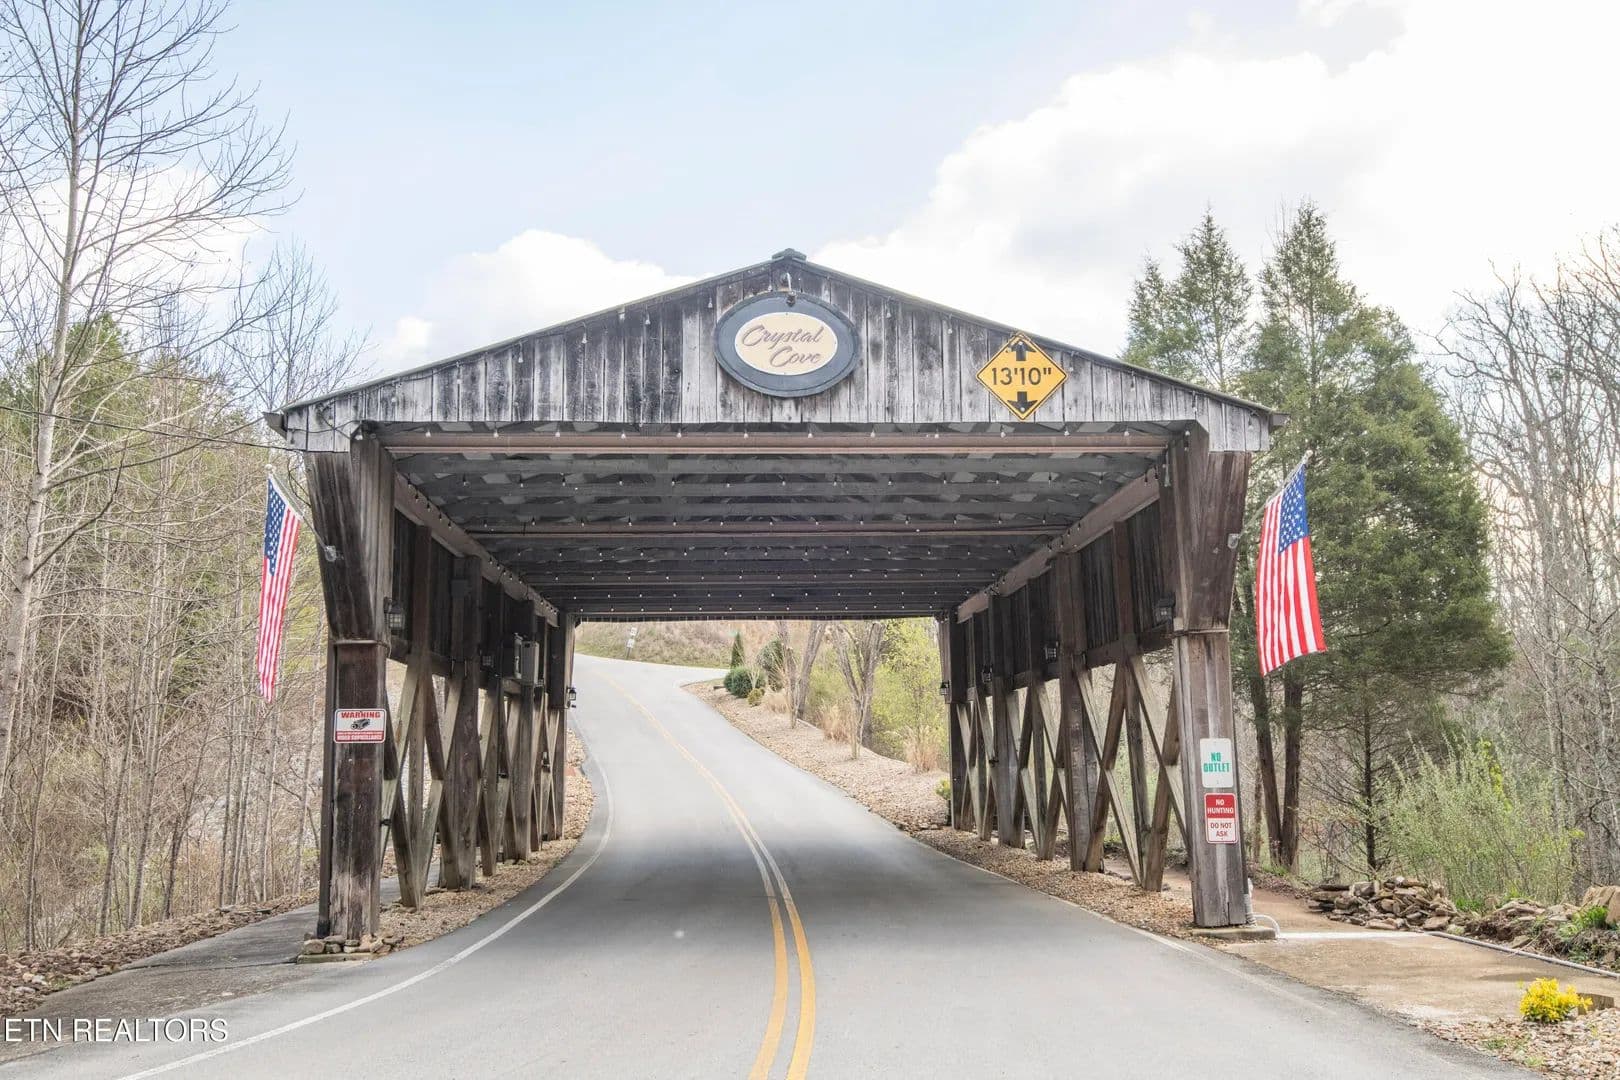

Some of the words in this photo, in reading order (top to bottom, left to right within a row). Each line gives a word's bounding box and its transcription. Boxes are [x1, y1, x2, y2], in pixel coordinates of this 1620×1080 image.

[741, 324, 824, 349] Crystal
[769, 345, 821, 367] Cove
[991, 367, 1052, 385] 13'10"
[1211, 752, 1221, 762] NO
[1203, 762, 1230, 772] OUTLET
